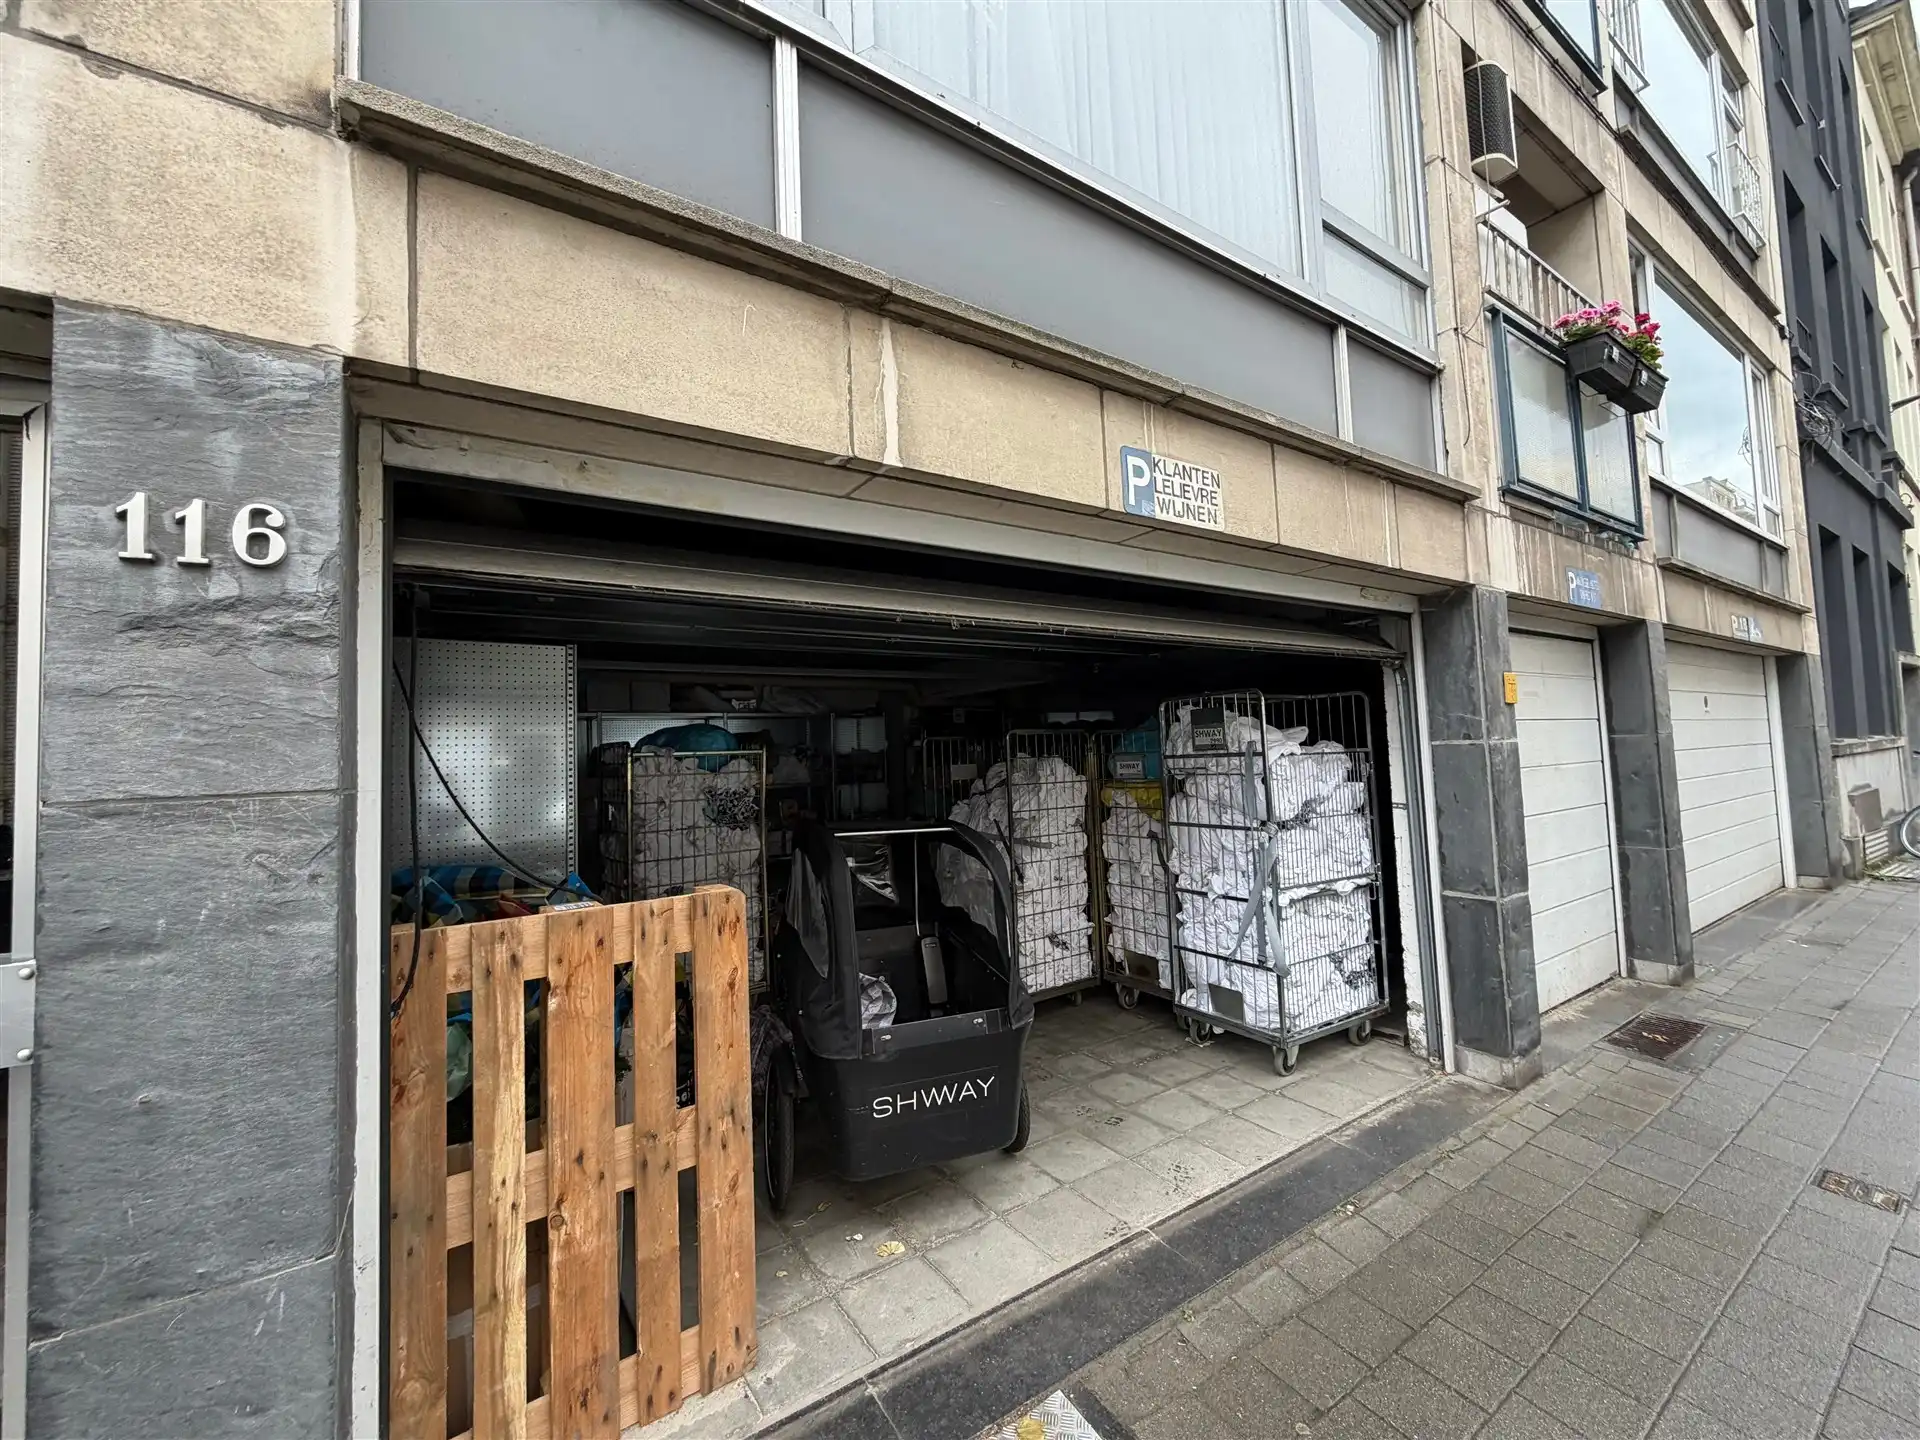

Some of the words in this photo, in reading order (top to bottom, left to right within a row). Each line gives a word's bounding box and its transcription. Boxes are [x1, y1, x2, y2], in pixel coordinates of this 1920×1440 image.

[1126, 454, 1151, 506] P
[1152, 456, 1221, 489] KLANTEN
[1153, 476, 1219, 507] LELIEVRE
[1156, 496, 1218, 525] WIJNEN
[115, 491, 288, 566] 116
[1194, 729, 1222, 738] SHWAY
[872, 1075, 995, 1118] SHWAY
